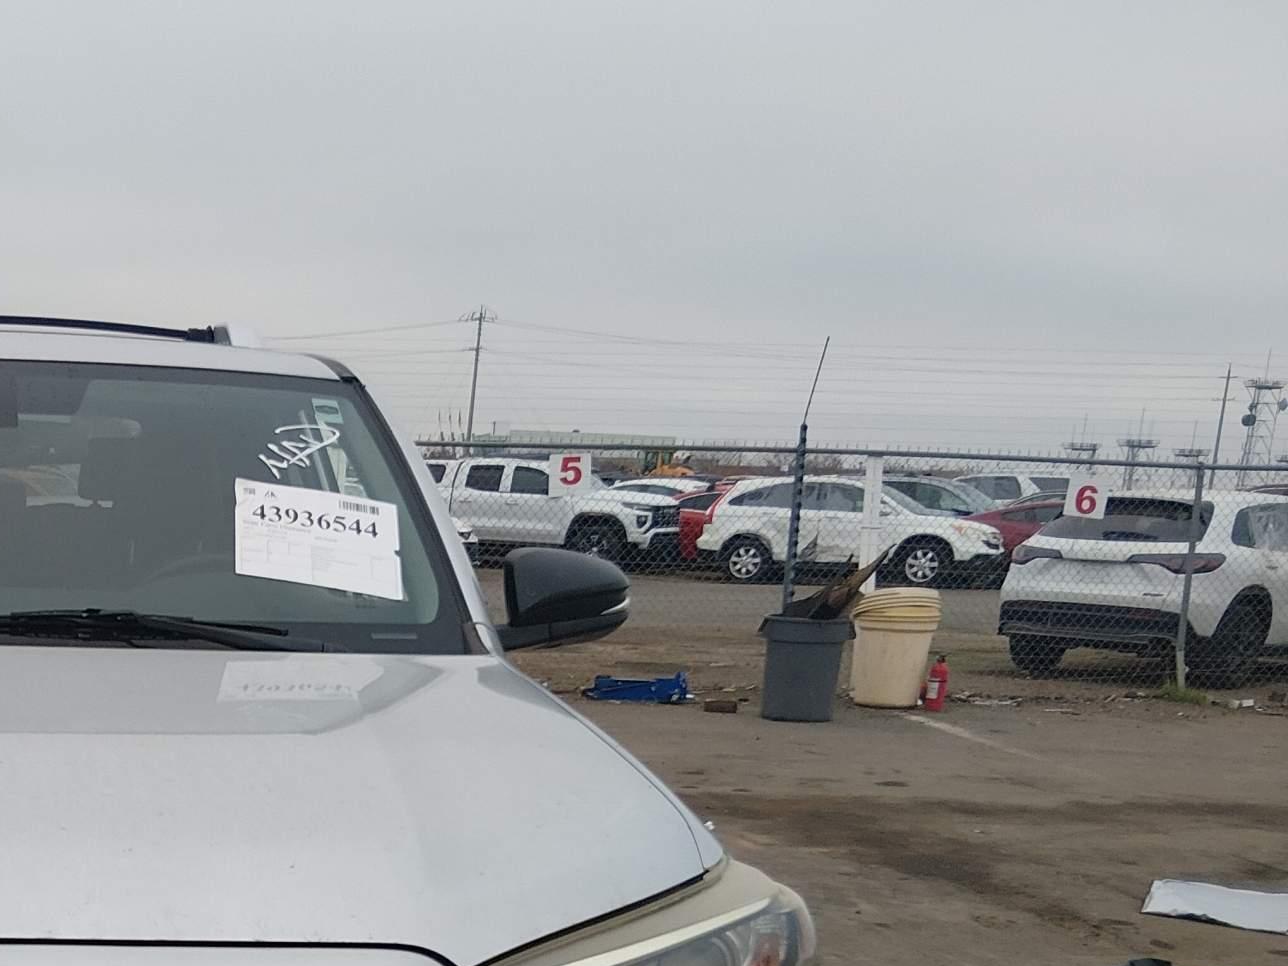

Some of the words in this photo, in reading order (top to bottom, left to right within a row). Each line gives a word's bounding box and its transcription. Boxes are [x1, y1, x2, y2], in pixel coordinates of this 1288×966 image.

[559, 456, 582, 486] 5
[1075, 484, 1098, 515] 6
[251, 504, 379, 538] 43936544
